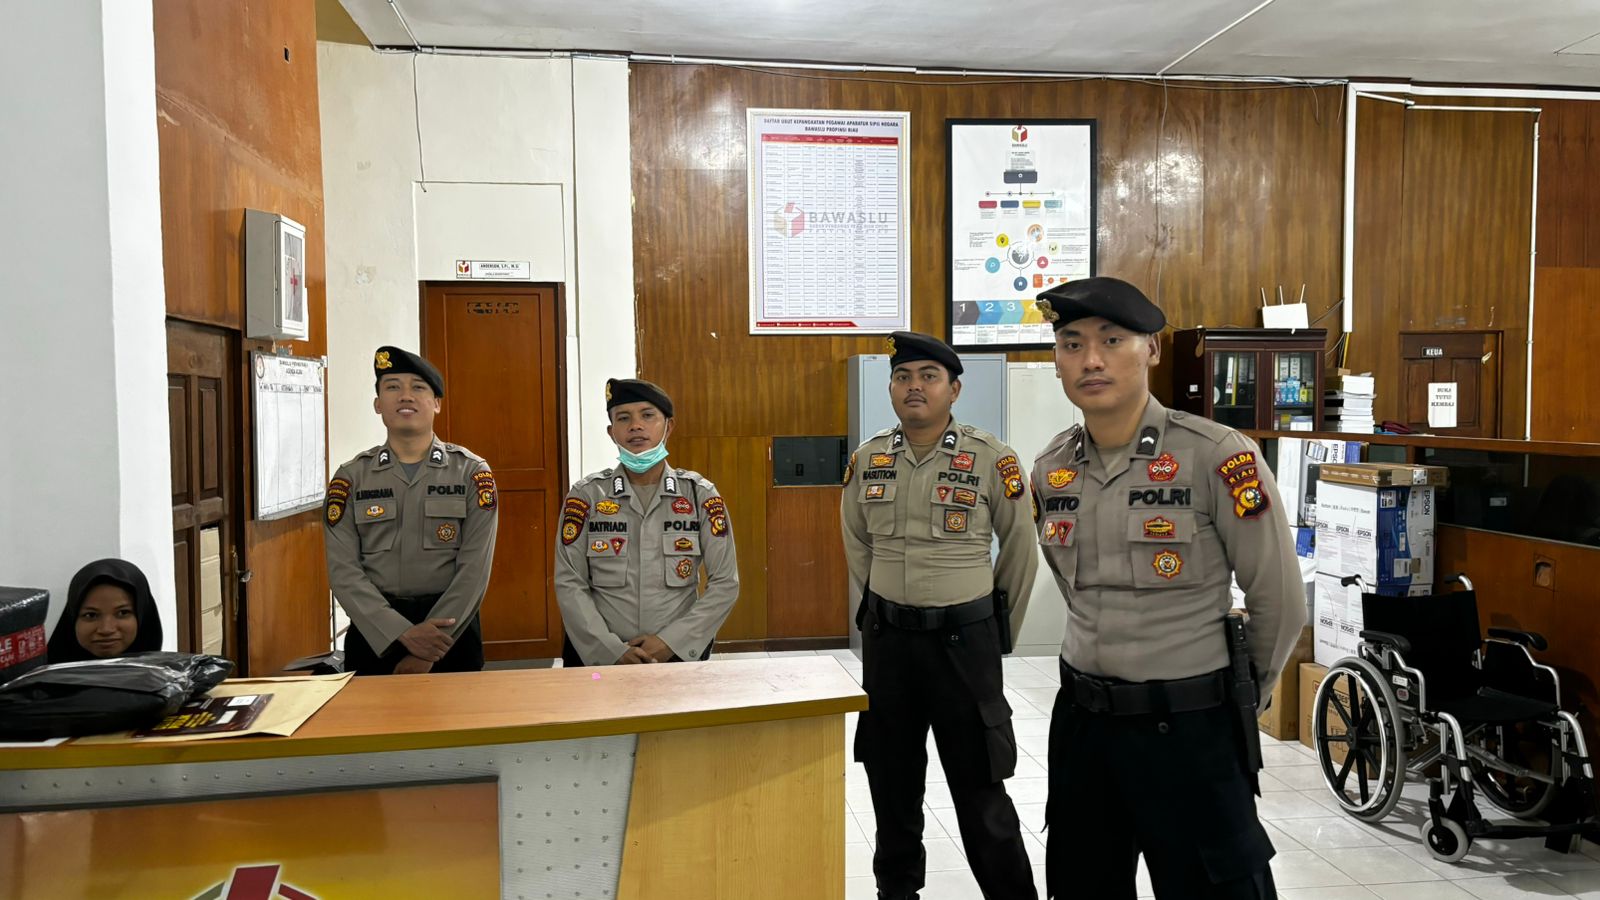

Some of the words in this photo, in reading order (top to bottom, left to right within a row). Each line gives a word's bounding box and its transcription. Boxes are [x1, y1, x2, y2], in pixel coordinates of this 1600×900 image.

[809, 212, 887, 223] BAWASLU
[960, 303, 966, 312] 1
[985, 303, 994, 312] 2
[1006, 302, 1016, 312] 3
[997, 456, 1016, 469] POLDA
[1221, 453, 1253, 475] POLDA
[1002, 467, 1018, 475] RIAU
[1229, 468, 1255, 484] RIAU
[938, 471, 980, 487] POLRI
[428, 484, 466, 495] POLRI
[1129, 487, 1192, 506] POLRI
[589, 521, 627, 532] BATRIADI
[664, 520, 700, 532] POLRI
